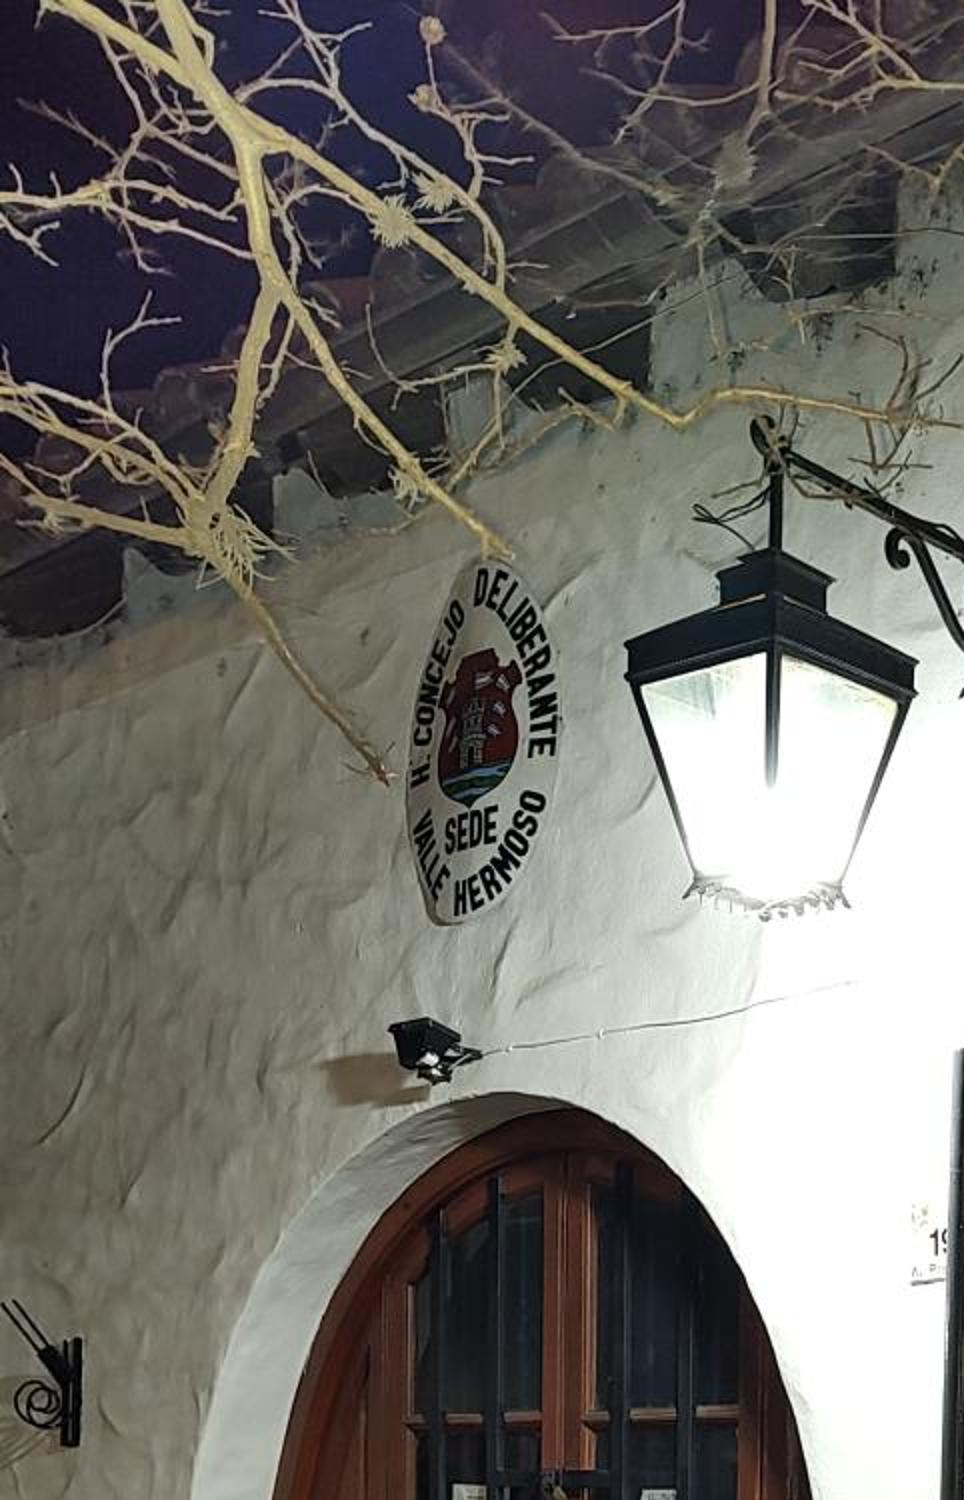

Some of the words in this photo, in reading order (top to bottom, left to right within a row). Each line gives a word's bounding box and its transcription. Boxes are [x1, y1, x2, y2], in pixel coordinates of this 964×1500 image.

[413, 599, 465, 746] CONCEJO
[473, 567, 558, 758] DELIBERANTE
[410, 753, 431, 788] H.
[445, 804, 499, 855] SEDE
[413, 808, 451, 901] VALLE
[454, 790, 547, 917] HERMOSO
